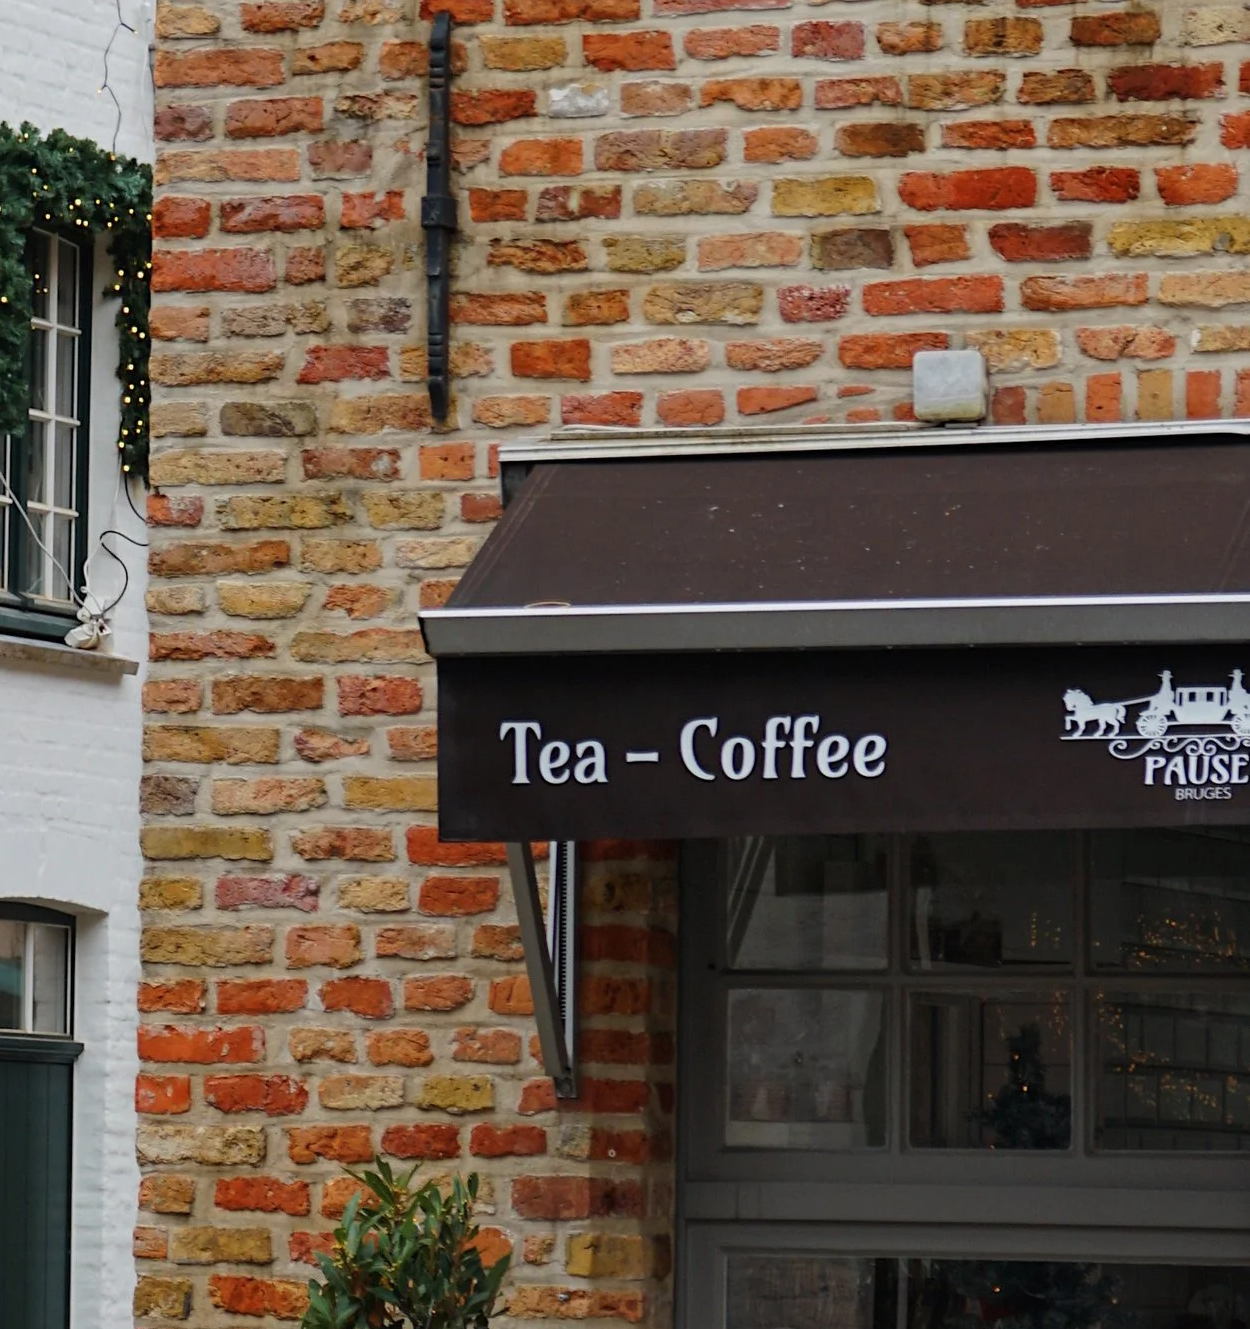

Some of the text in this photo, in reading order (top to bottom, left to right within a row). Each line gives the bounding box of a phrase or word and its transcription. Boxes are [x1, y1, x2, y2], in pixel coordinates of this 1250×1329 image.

[499, 721, 609, 785] Tea
[680, 714, 887, 781] Coffee
[1144, 754, 1250, 786] PAUSE
[1174, 787, 1232, 801] BRUGES
